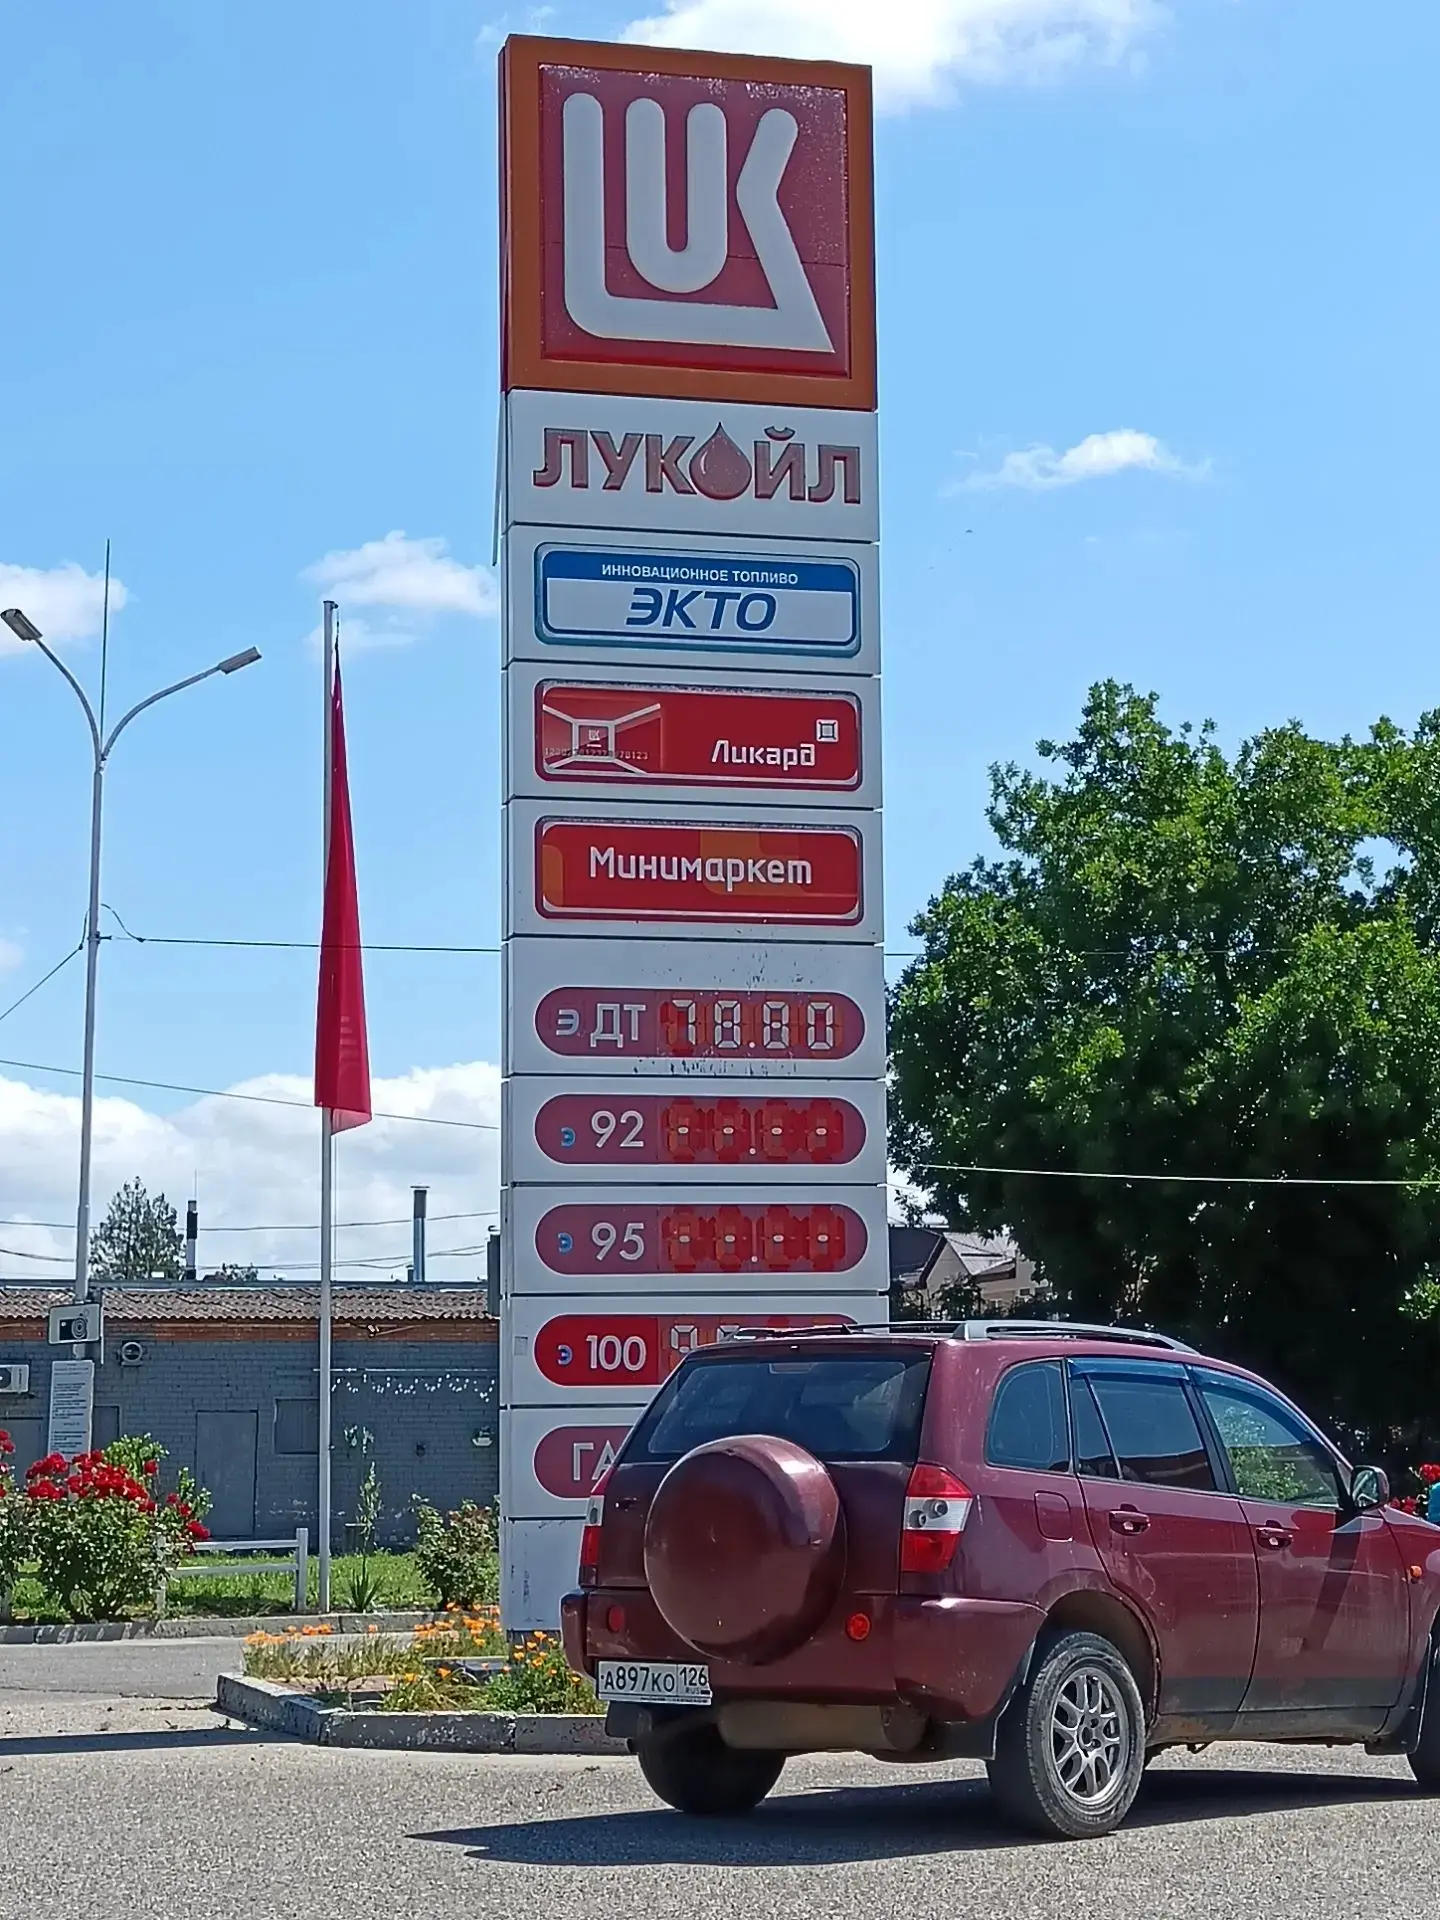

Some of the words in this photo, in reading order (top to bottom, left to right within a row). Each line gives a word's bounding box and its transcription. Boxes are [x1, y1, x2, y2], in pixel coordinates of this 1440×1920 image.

[601, 563, 729, 582] ИННОВАЦИОННОЕ
[731, 569, 799, 585] ТОПЛИВО
[625, 587, 777, 631] ЭКТО
[711, 739, 815, 771] Ликард
[589, 846, 813, 892] Минимаркет
[589, 1003, 647, 1048] ДТ
[590, 1110, 645, 1149] 92
[591, 1222, 645, 1261] 95
[586, 1335, 647, 1371] 100
[679, 1667, 708, 1686] 126
